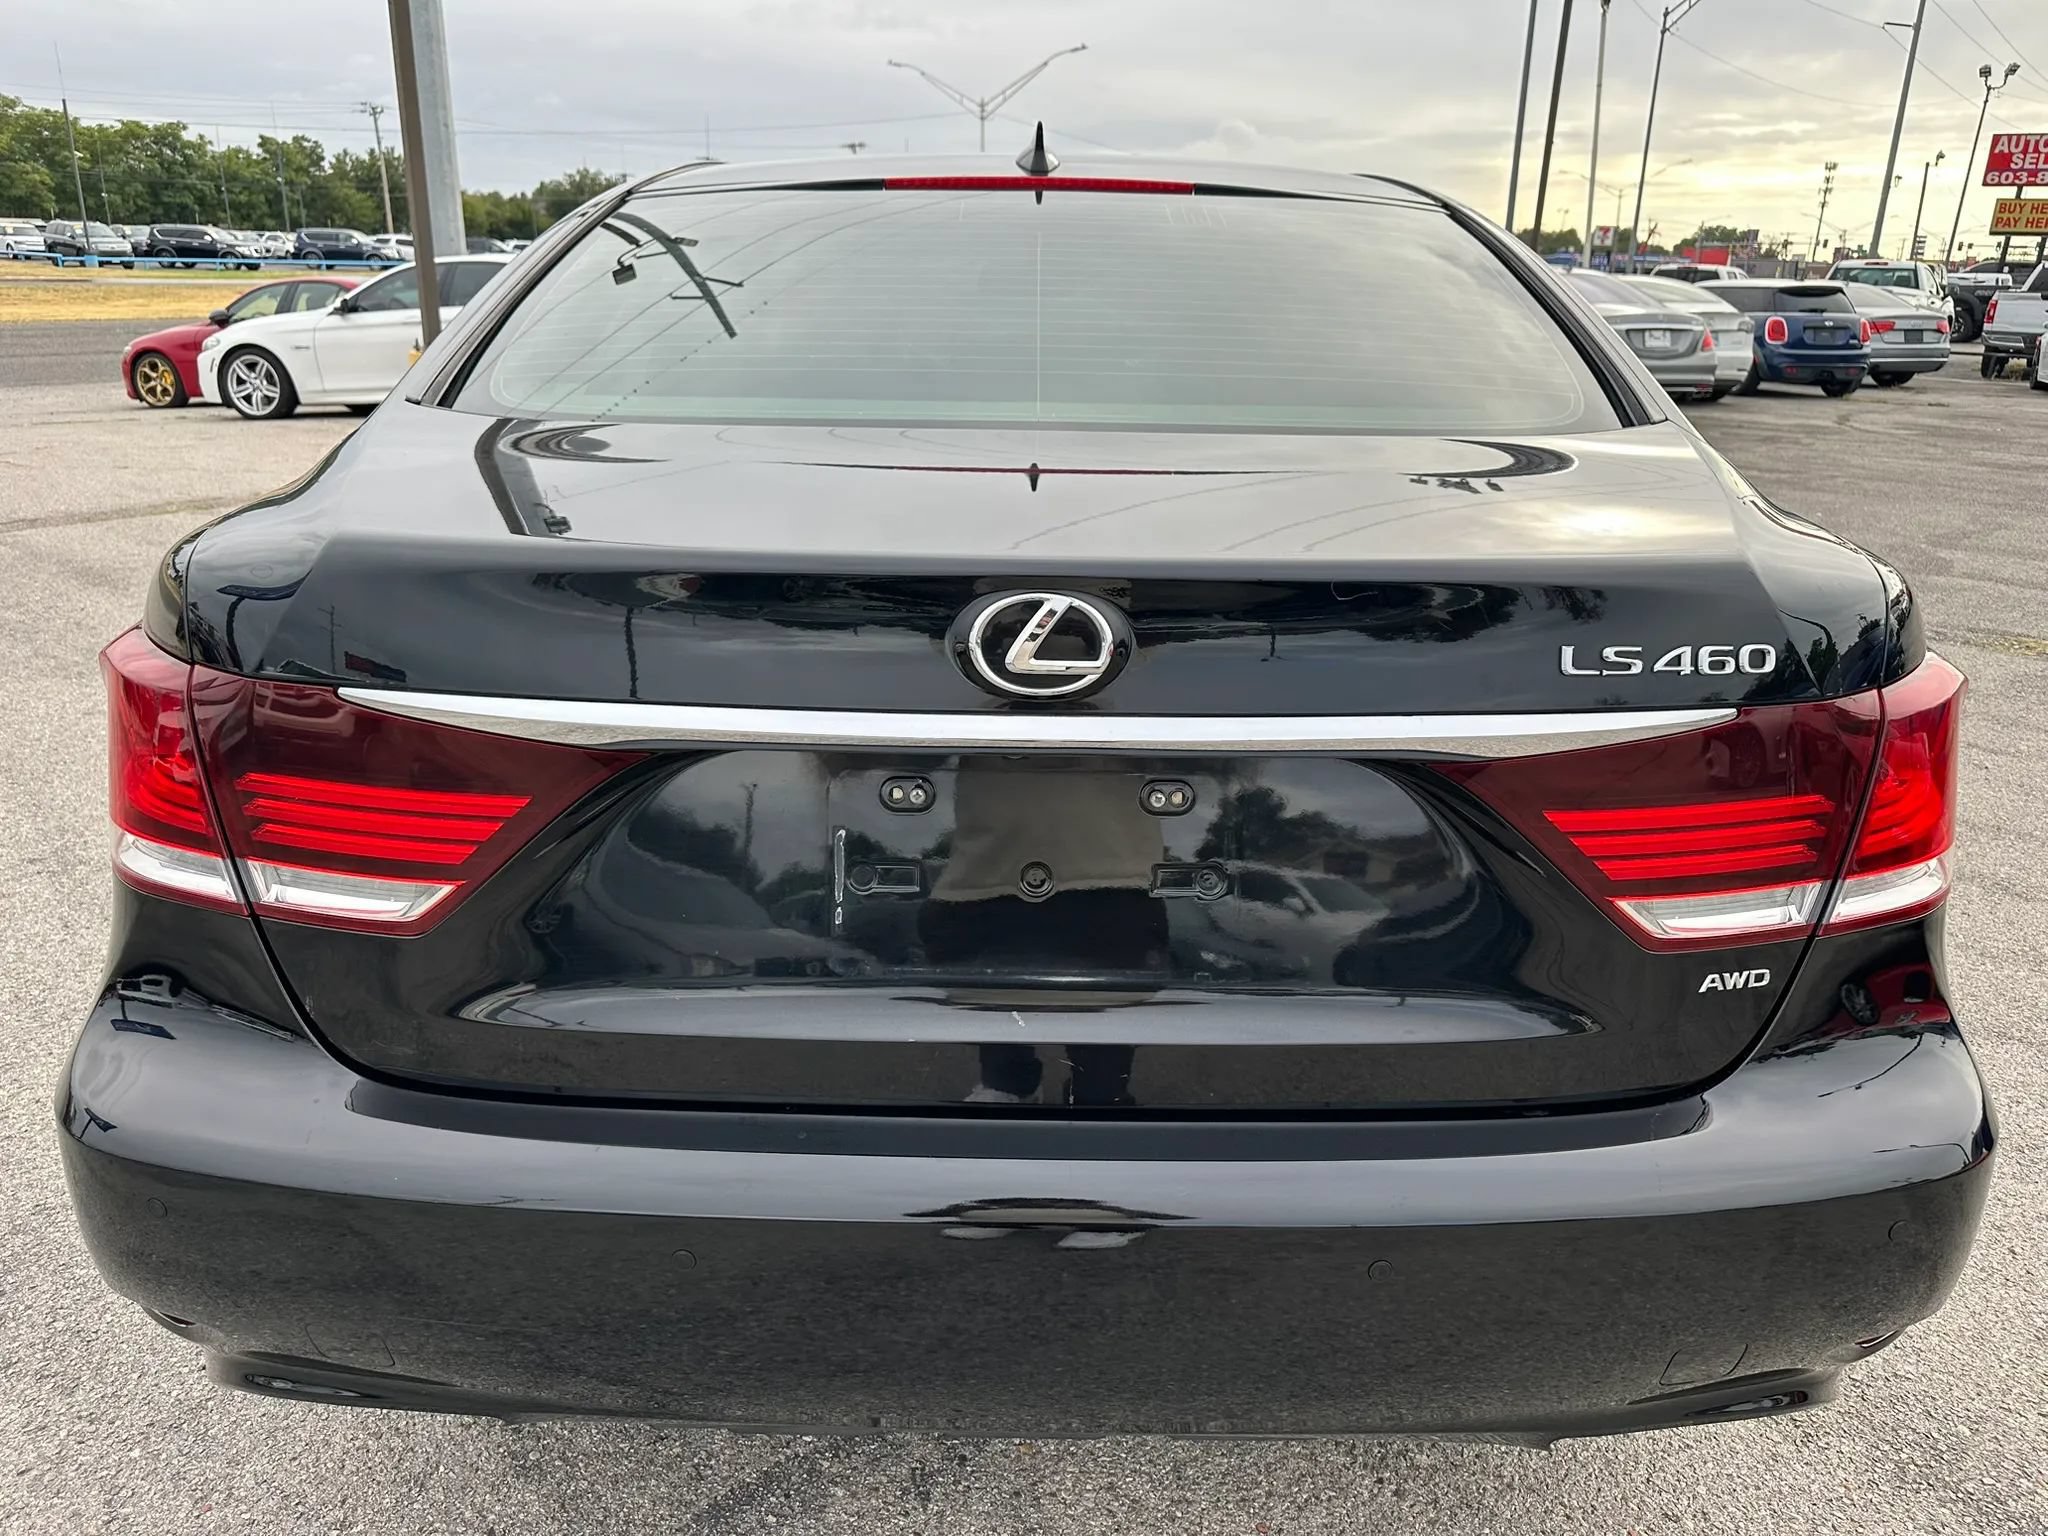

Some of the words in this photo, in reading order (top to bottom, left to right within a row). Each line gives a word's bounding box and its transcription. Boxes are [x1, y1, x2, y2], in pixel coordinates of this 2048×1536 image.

[1986, 171, 2048, 184] 603-8
[1999, 202, 2027, 214] BUY
[1994, 216, 2021, 228] PAY
[1560, 645, 1643, 676] LS
[1653, 643, 1776, 676] 460
[1697, 968, 1771, 993] AWD
